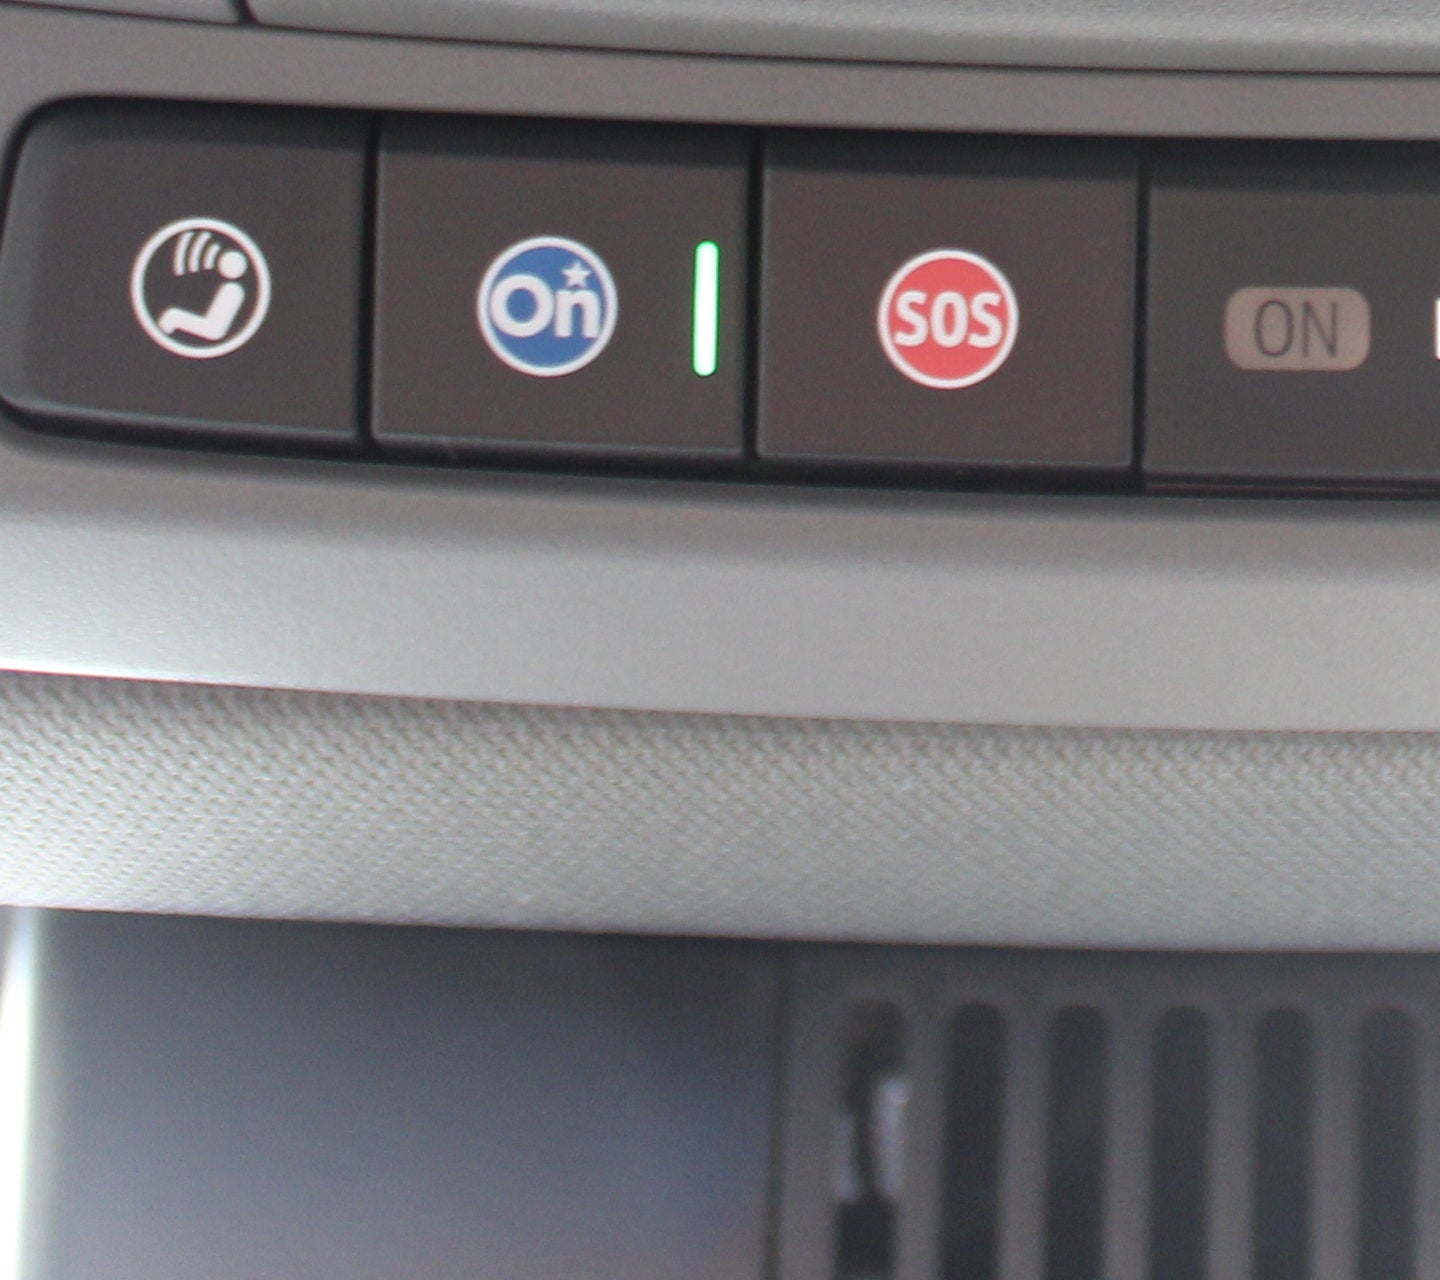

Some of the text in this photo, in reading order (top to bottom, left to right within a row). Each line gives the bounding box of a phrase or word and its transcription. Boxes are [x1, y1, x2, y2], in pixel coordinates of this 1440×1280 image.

[489, 272, 601, 338] On
[894, 290, 1003, 349] SOS
[1254, 298, 1338, 358] ON
